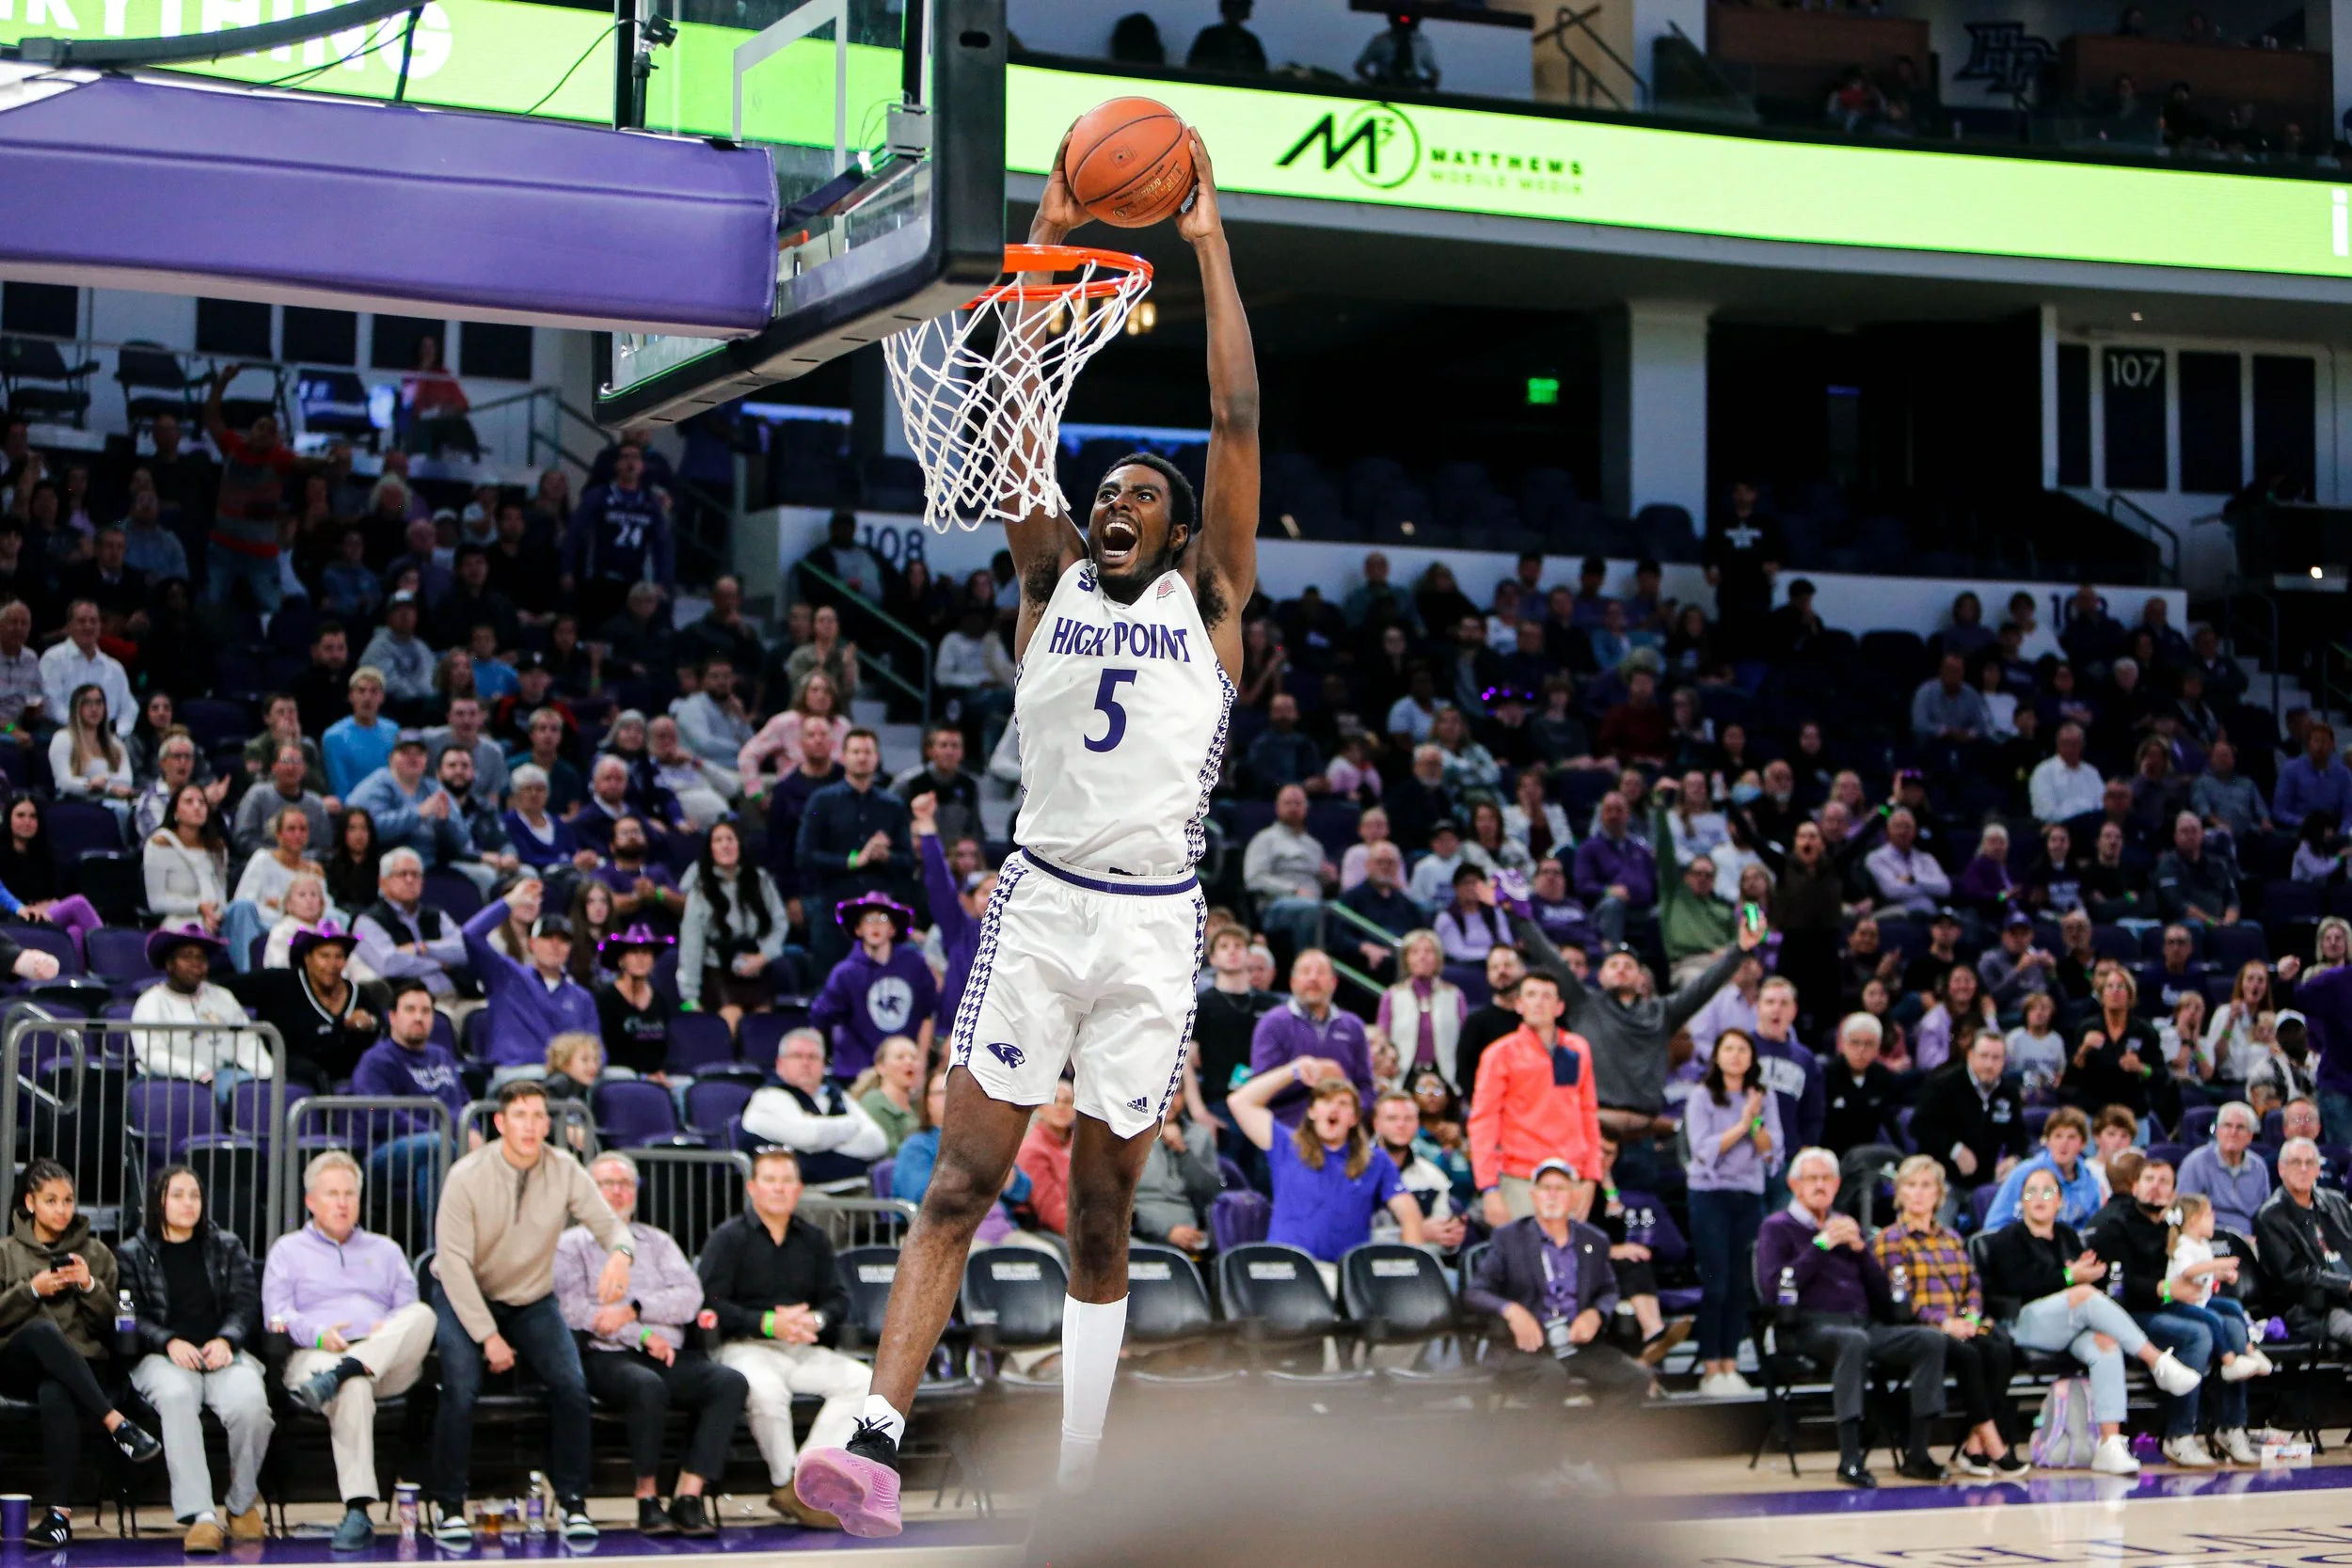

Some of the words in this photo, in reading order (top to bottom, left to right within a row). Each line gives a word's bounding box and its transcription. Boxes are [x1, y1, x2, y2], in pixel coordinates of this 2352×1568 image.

[1431, 149, 1582, 176] MATTHEWS
[2109, 354, 2161, 388] 107
[1048, 617, 1111, 657] HIGH
[1113, 622, 1191, 663] POINT
[1083, 668, 1137, 752] 5
